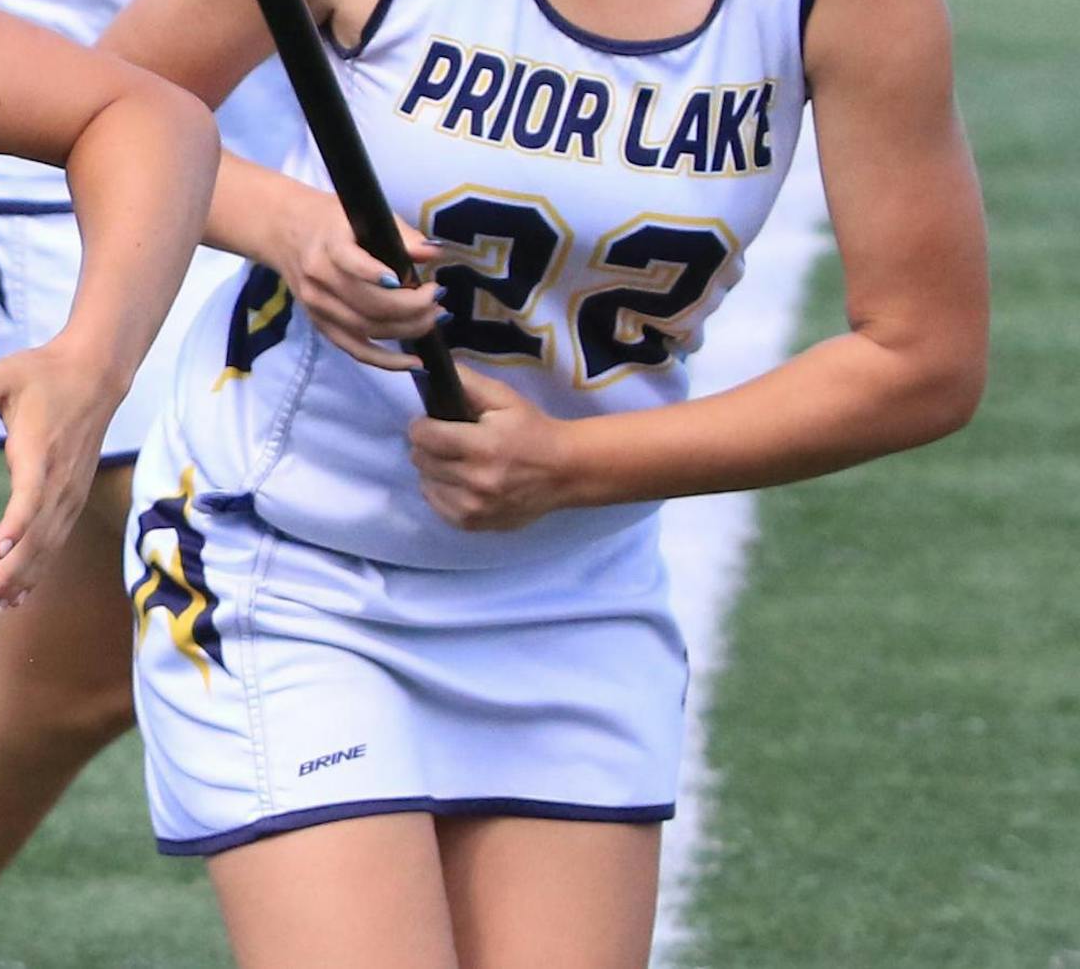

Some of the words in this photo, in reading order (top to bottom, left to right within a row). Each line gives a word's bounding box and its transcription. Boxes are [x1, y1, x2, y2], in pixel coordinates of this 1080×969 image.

[397, 38, 612, 161] PRIOR
[622, 81, 774, 174] LAKE
[425, 190, 734, 384] 22
[298, 742, 367, 778] BRINE
